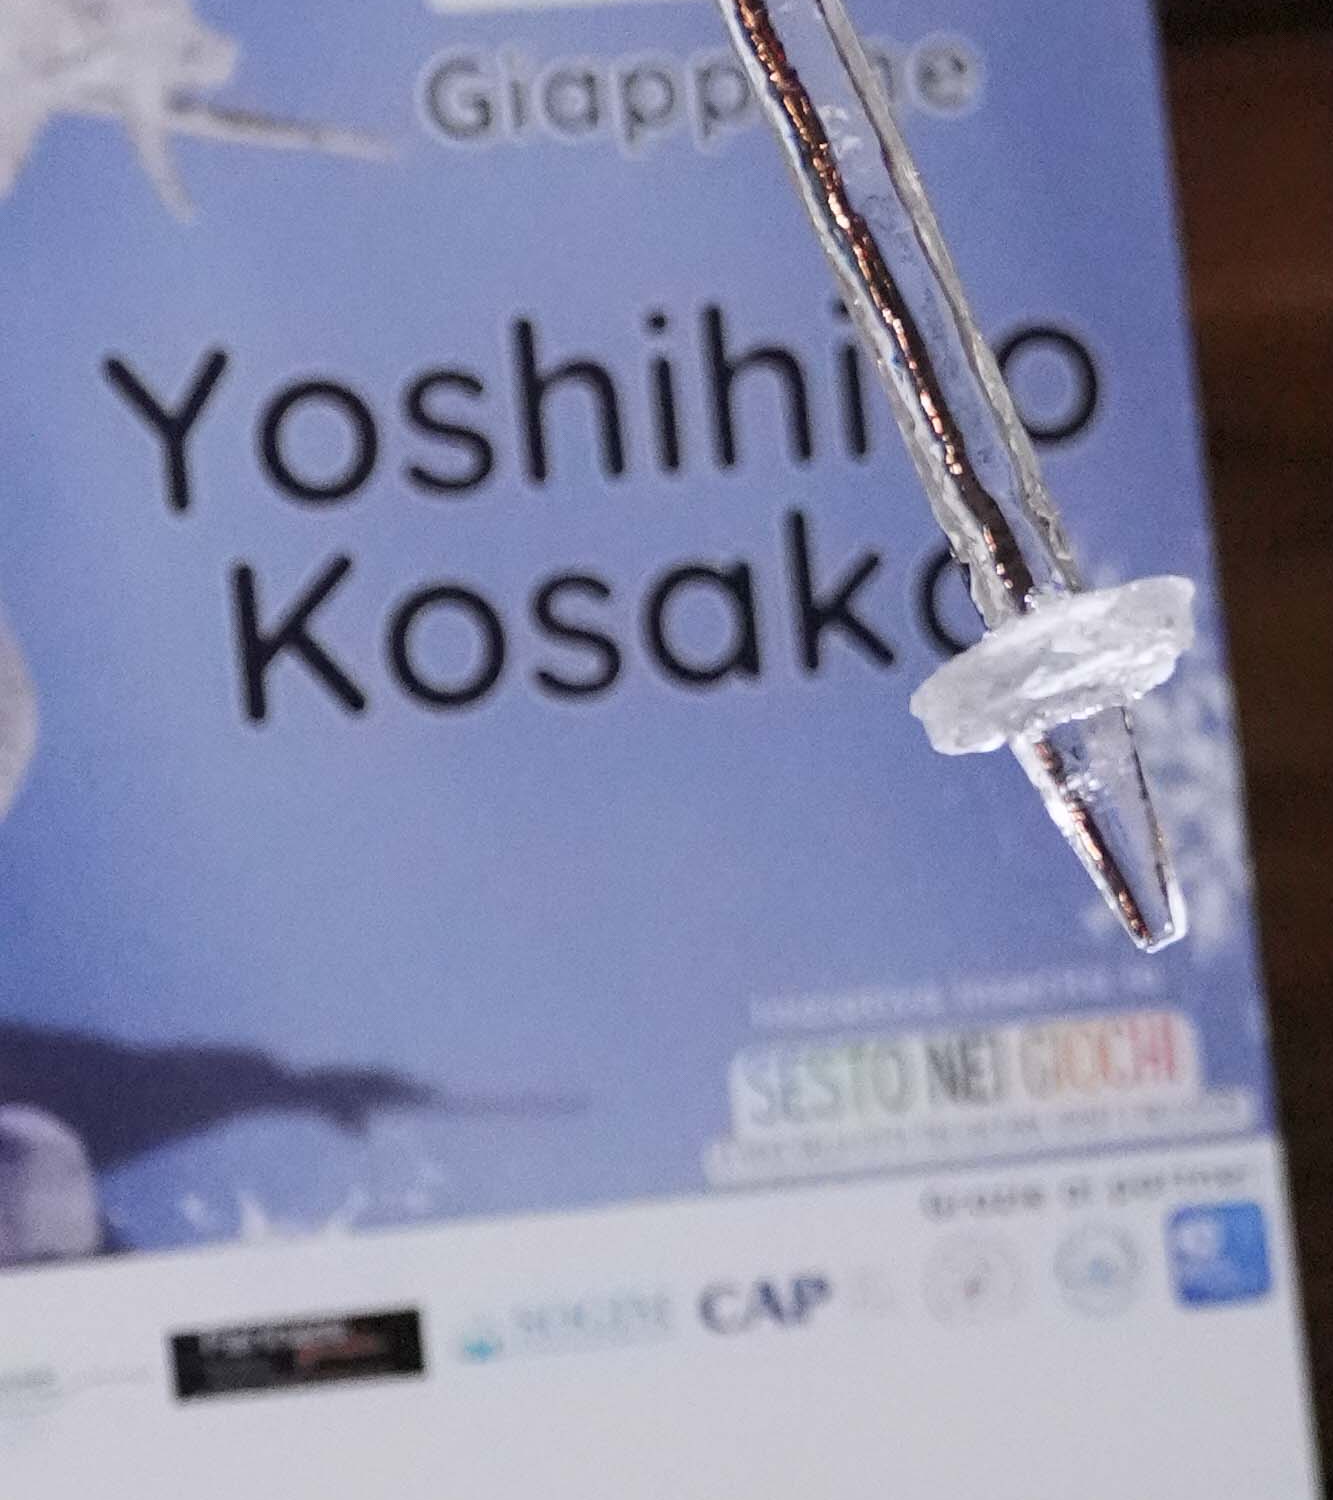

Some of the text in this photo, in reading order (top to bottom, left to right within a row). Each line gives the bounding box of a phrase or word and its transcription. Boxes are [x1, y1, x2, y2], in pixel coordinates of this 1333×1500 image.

[423, 38, 978, 150] Giappe
[104, 298, 1099, 513] Yoshihio
[745, 1012, 1182, 1126] SESTO NEI GIOCHI
[697, 1274, 832, 1335] CAP
